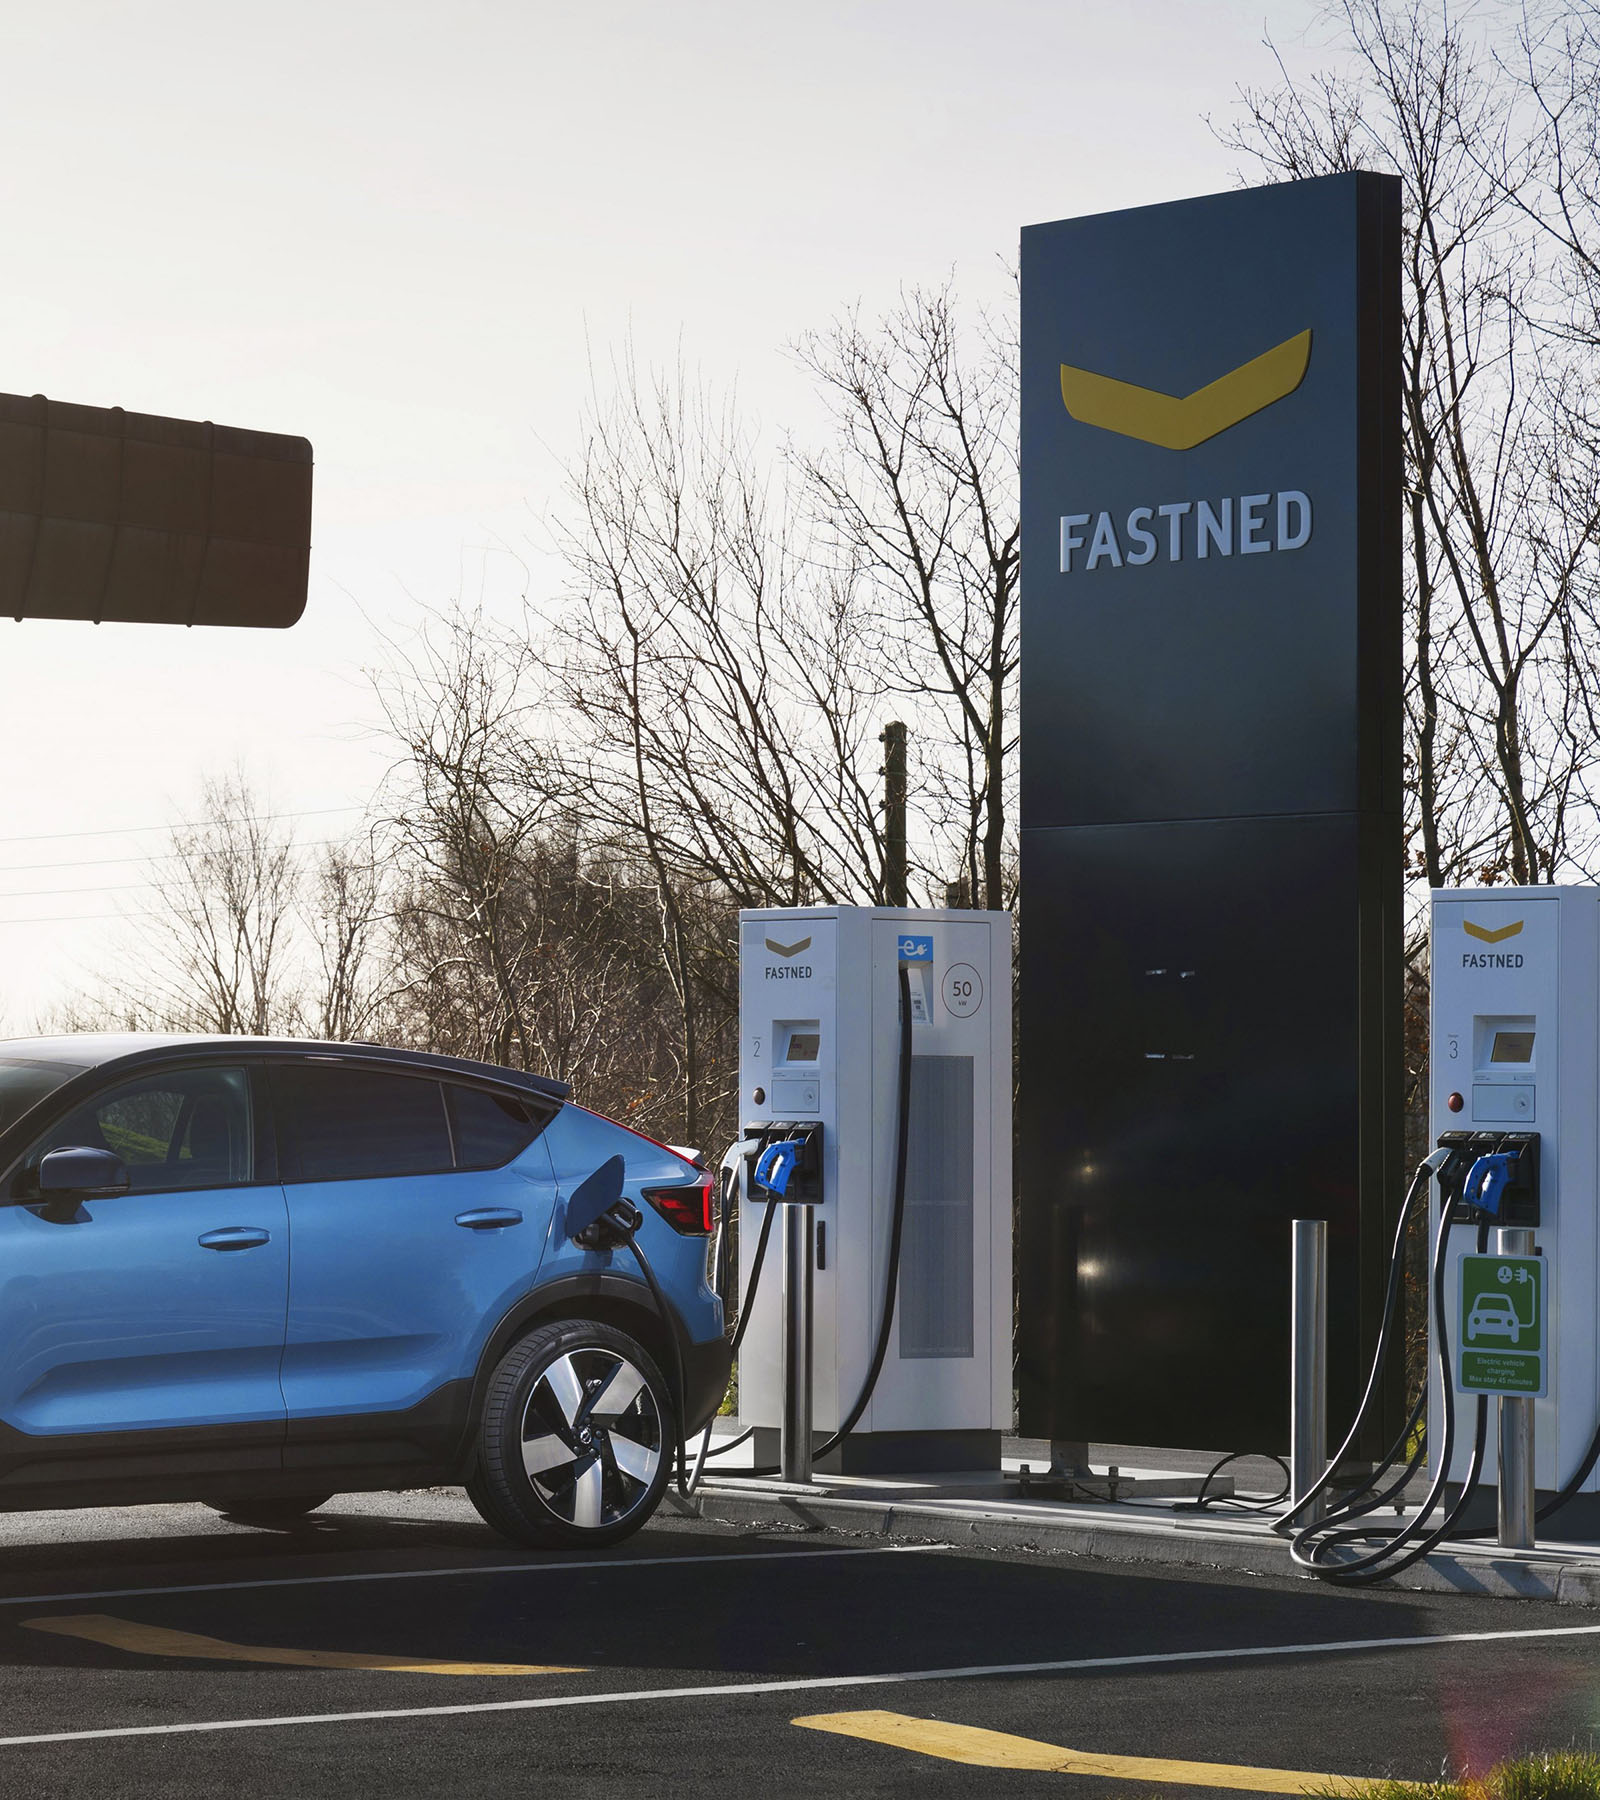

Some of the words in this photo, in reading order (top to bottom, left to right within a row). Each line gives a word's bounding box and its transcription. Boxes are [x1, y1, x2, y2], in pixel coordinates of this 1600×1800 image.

[1059, 490, 1312, 573] FASTNED
[1462, 954, 1524, 968] FASTNED
[765, 966, 812, 979] FASTNED
[953, 981, 972, 997] 50
[753, 1040, 761, 1058] 2
[1449, 1040, 1458, 1059] 3
[1476, 1357, 1500, 1365] Electric
[1503, 1359, 1525, 1368] vehicle
[1487, 1368, 1515, 1377] charging
[1483, 1376, 1497, 1384] stay
